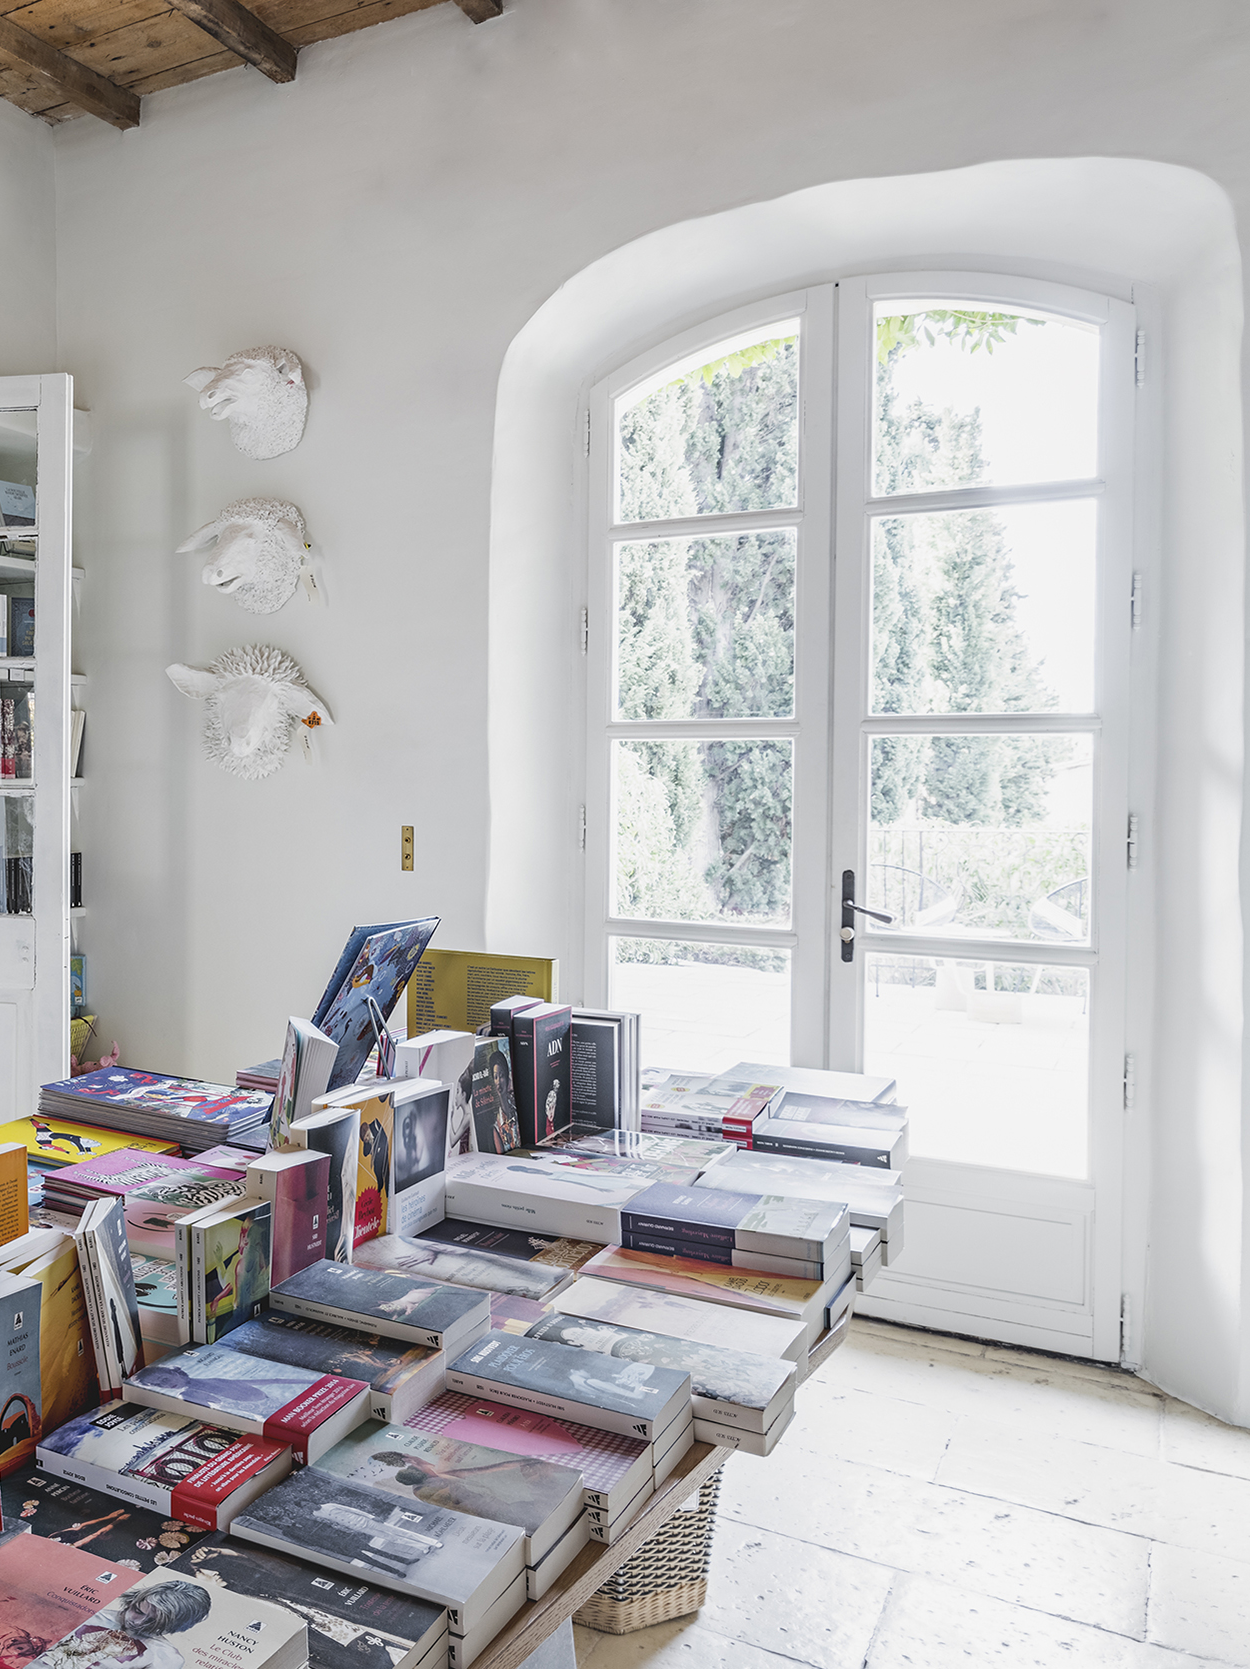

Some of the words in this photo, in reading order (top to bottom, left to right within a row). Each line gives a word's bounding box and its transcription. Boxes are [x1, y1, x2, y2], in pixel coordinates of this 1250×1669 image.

[546, 1038, 563, 1058] ADN
[7, 1332, 28, 1346] MATHIAS
[10, 1344, 26, 1356] ENARD
[470, 1355, 484, 1363] SIRI
[478, 1340, 502, 1357] HUSTVEDT
[7, 1355, 28, 1371] Boussole
[281, 1411, 295, 1423] MAN
[293, 1397, 313, 1414] BOOKER
[311, 1387, 329, 1400] PRIZE
[96, 1414, 117, 1425] EDDIE
[104, 1416, 125, 1428] JOYCE
[63, 1586, 101, 1606] VUILLARD
[80, 1584, 99, 1595] ÉRIC
[217, 1636, 255, 1653] HUSTON
[228, 1630, 259, 1646] NANCY
[192, 1647, 208, 1657] des
[210, 1644, 221, 1652] Le
[222, 1649, 242, 1661] Club
